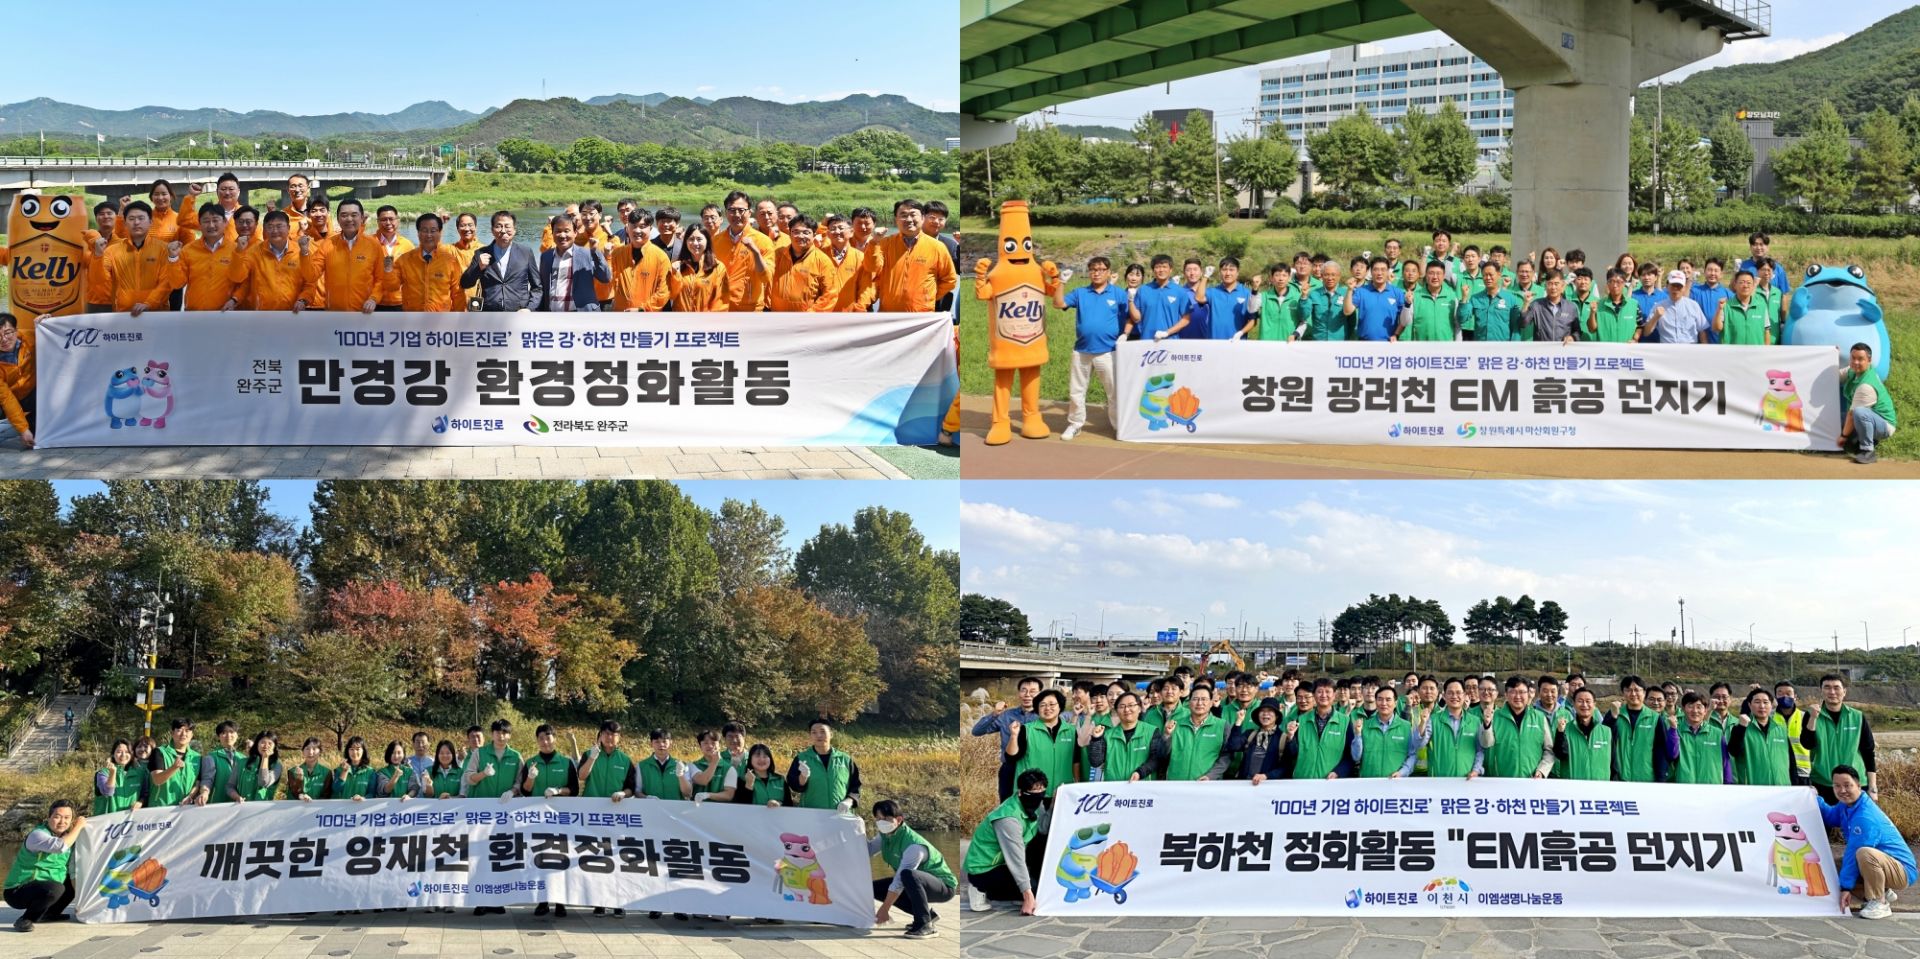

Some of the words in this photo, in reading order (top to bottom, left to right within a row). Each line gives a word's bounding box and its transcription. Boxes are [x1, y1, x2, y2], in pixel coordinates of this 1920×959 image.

[12, 256, 81, 287] Kelly
[999, 301, 1045, 322] Kelly
[102, 333, 143, 342] 하이트진로
[389, 331, 421, 348] 기업
[521, 331, 555, 349] 맑은
[558, 331, 616, 349] 강·하천
[619, 331, 670, 349] 만들기
[674, 331, 740, 349] 프로젝트
[1171, 354, 1203, 362] 하이트진로
[1377, 356, 1400, 369] 기업
[1478, 357, 1503, 370] 맑은
[1506, 357, 1549, 370] 강·하천
[1553, 357, 1591, 370] 만들기
[1593, 358, 1645, 371] 프로젝트
[252, 359, 283, 375] 전북
[236, 378, 283, 395] 완주군
[300, 358, 451, 406] 만경강
[476, 358, 791, 407] 환경정화활동
[1241, 375, 1314, 412] 창원
[1327, 376, 1435, 413] 광려천
[1450, 379, 1518, 412] EM
[1532, 377, 1604, 414] 흙공
[1618, 379, 1727, 415] 던지기
[451, 419, 504, 431] 하이트진로
[553, 420, 595, 432] 전라북도
[597, 420, 629, 432] 완주군
[1403, 426, 1445, 436] 하이트진로
[1479, 426, 1523, 436] 창원특례시
[1525, 426, 1577, 436] 마산회원구청
[1114, 799, 1154, 808] 하이트진로
[1321, 799, 1350, 815] 기업
[1441, 799, 1471, 815] 맑은
[1474, 799, 1526, 815] 강·하천
[1530, 799, 1576, 815] 만들기
[1579, 800, 1640, 816] 프로젝트
[136, 821, 172, 832] 하이트진로
[360, 813, 386, 826] 기업
[466, 812, 492, 825] 맑은
[496, 812, 541, 825] 강·하천
[544, 812, 584, 826] 만들기
[588, 813, 643, 828] 프로젝트
[200, 837, 329, 881] 깨끗한
[345, 833, 469, 875] 양재천
[489, 832, 751, 884] 환경정화활동
[1159, 831, 1273, 872] 복하천
[1284, 830, 1435, 872] 정화활동
[1448, 828, 1617, 872] "EM흙공
[1626, 830, 1756, 872] 던지기"
[424, 883, 469, 894] 하이트진로
[475, 880, 546, 894] 이엠생명나눔운동
[1364, 892, 1418, 905] 하이트진로
[1478, 892, 1563, 905] 이엠생명나눔운동
